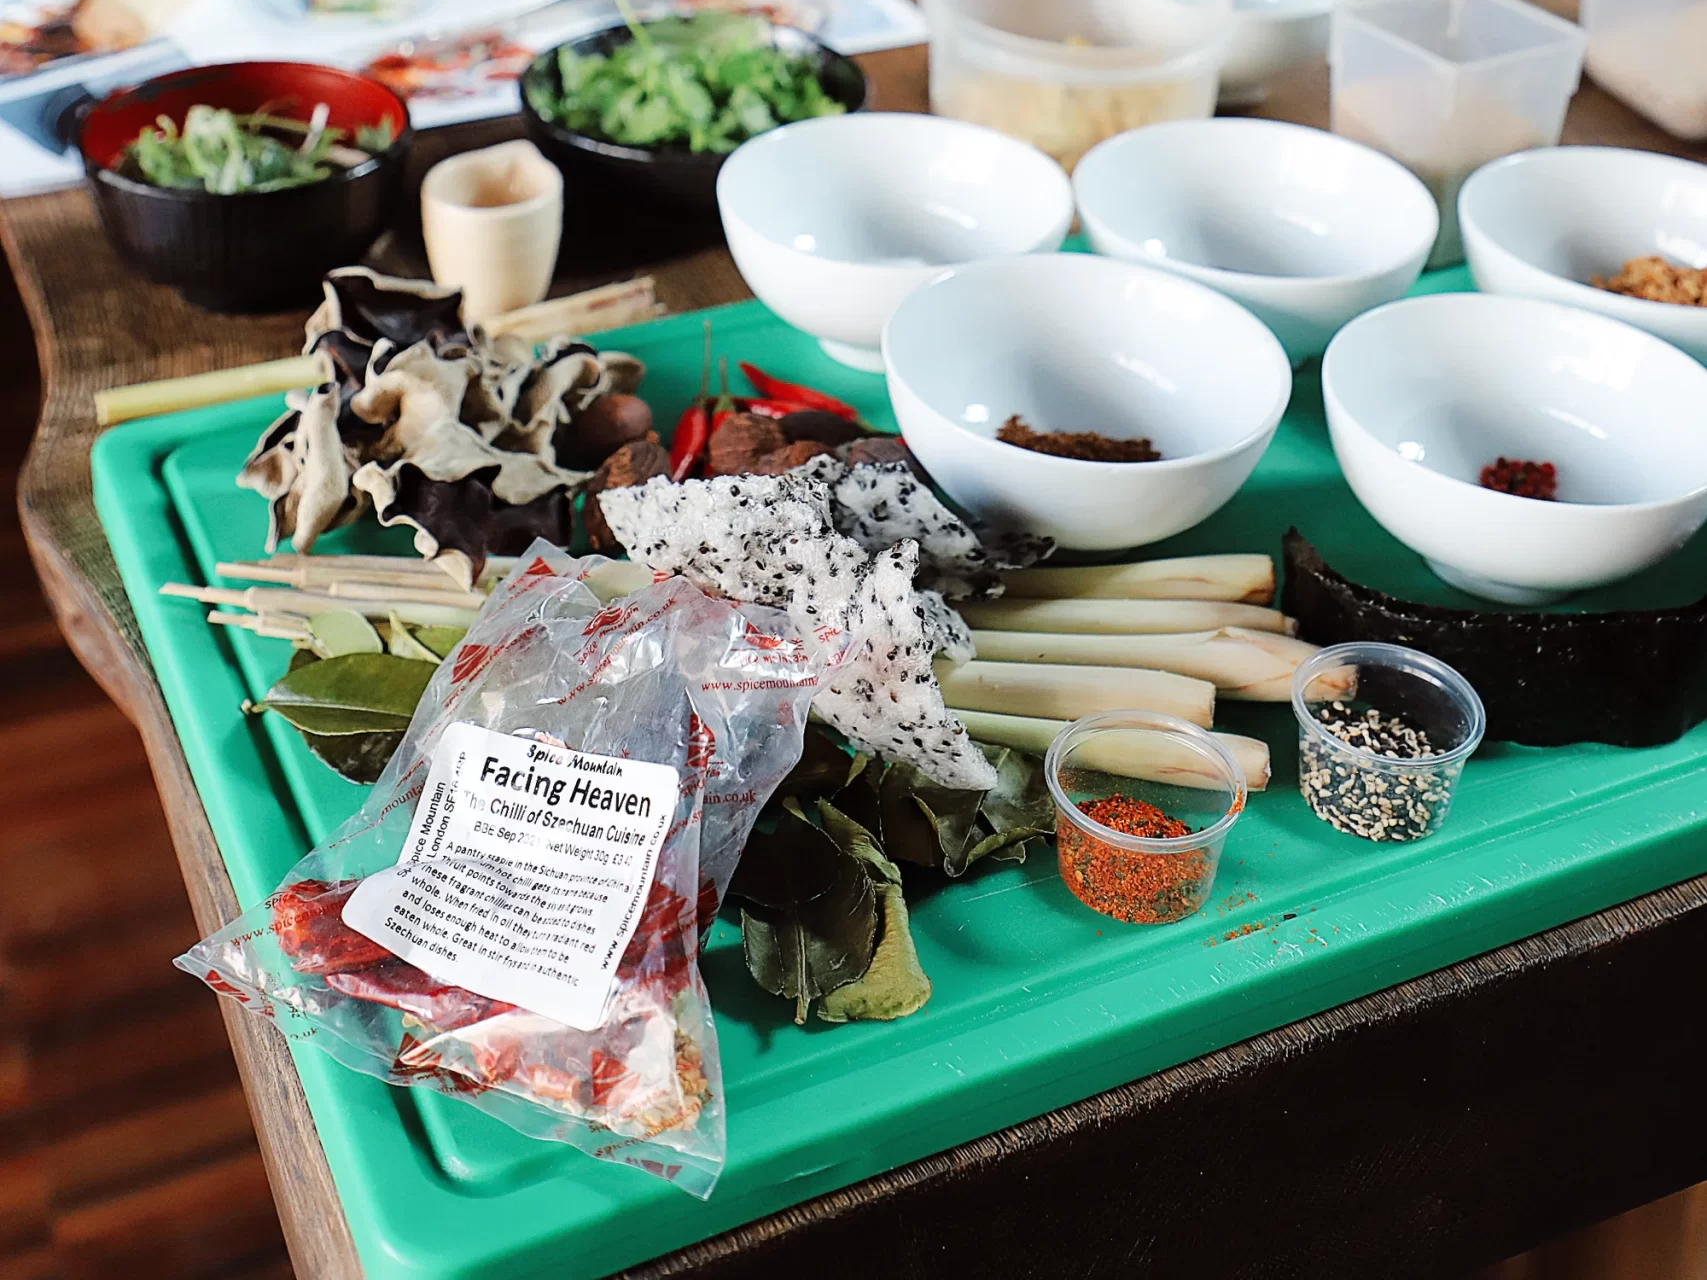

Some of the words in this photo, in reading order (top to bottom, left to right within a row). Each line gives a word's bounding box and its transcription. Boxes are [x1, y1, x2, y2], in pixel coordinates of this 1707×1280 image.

[527, 744, 564, 766] Spice
[567, 755, 623, 776] Mountain
[420, 782, 446, 836] Mountain
[480, 756, 567, 806] Facing
[569, 778, 651, 818] Heaven
[426, 816, 450, 858] London
[464, 790, 486, 812] The
[490, 798, 528, 822] Chilli
[527, 809, 544, 826] of
[542, 812, 604, 840] Szechuan
[606, 824, 646, 846] Cuisine
[474, 820, 494, 836] BBE
[496, 827, 516, 844] Sep
[546, 842, 563, 853] Net
[564, 844, 594, 862] Weight
[594, 850, 610, 866] 30g
[446, 841, 454, 851] A
[454, 844, 485, 860] pantry
[487, 853, 514, 867] staple
[514, 860, 523, 869] in
[523, 862, 538, 873] the
[538, 864, 569, 880] Sichuan
[569, 874, 598, 886] province
[466, 868, 496, 888] points
[495, 880, 530, 901] towards
[530, 894, 546, 908] the
[495, 868, 512, 880] hot
[512, 876, 532, 888] chilli
[531, 882, 551, 892] gets
[551, 885, 560, 896] its
[578, 890, 608, 903] because
[411, 876, 441, 900] whole.
[444, 892, 470, 910] When
[469, 902, 491, 918] fried
[490, 912, 500, 922] in
[499, 916, 512, 928] oil
[512, 922, 532, 939] they
[551, 932, 580, 948] radiant
[580, 940, 596, 954] red
[420, 864, 448, 882] These
[448, 876, 484, 900] fragrant
[484, 894, 514, 910] chillies
[512, 904, 530, 918] can
[531, 912, 542, 924] be
[561, 918, 570, 928] to
[570, 920, 596, 935] dishes
[384, 916, 429, 949] Szechuan
[428, 942, 458, 963] dishes.
[394, 904, 421, 926] eaten
[422, 920, 450, 940] whole.
[452, 932, 478, 952] Great
[478, 943, 488, 955] in
[488, 948, 504, 962] stir
[537, 965, 580, 987] authentic
[402, 890, 423, 906] and
[422, 900, 446, 918] loses
[445, 912, 478, 932] enough
[478, 925, 498, 941] heat
[498, 935, 510, 947] to
[510, 941, 530, 954] allow
[548, 950, 557, 960] to
[558, 951, 570, 964] be
